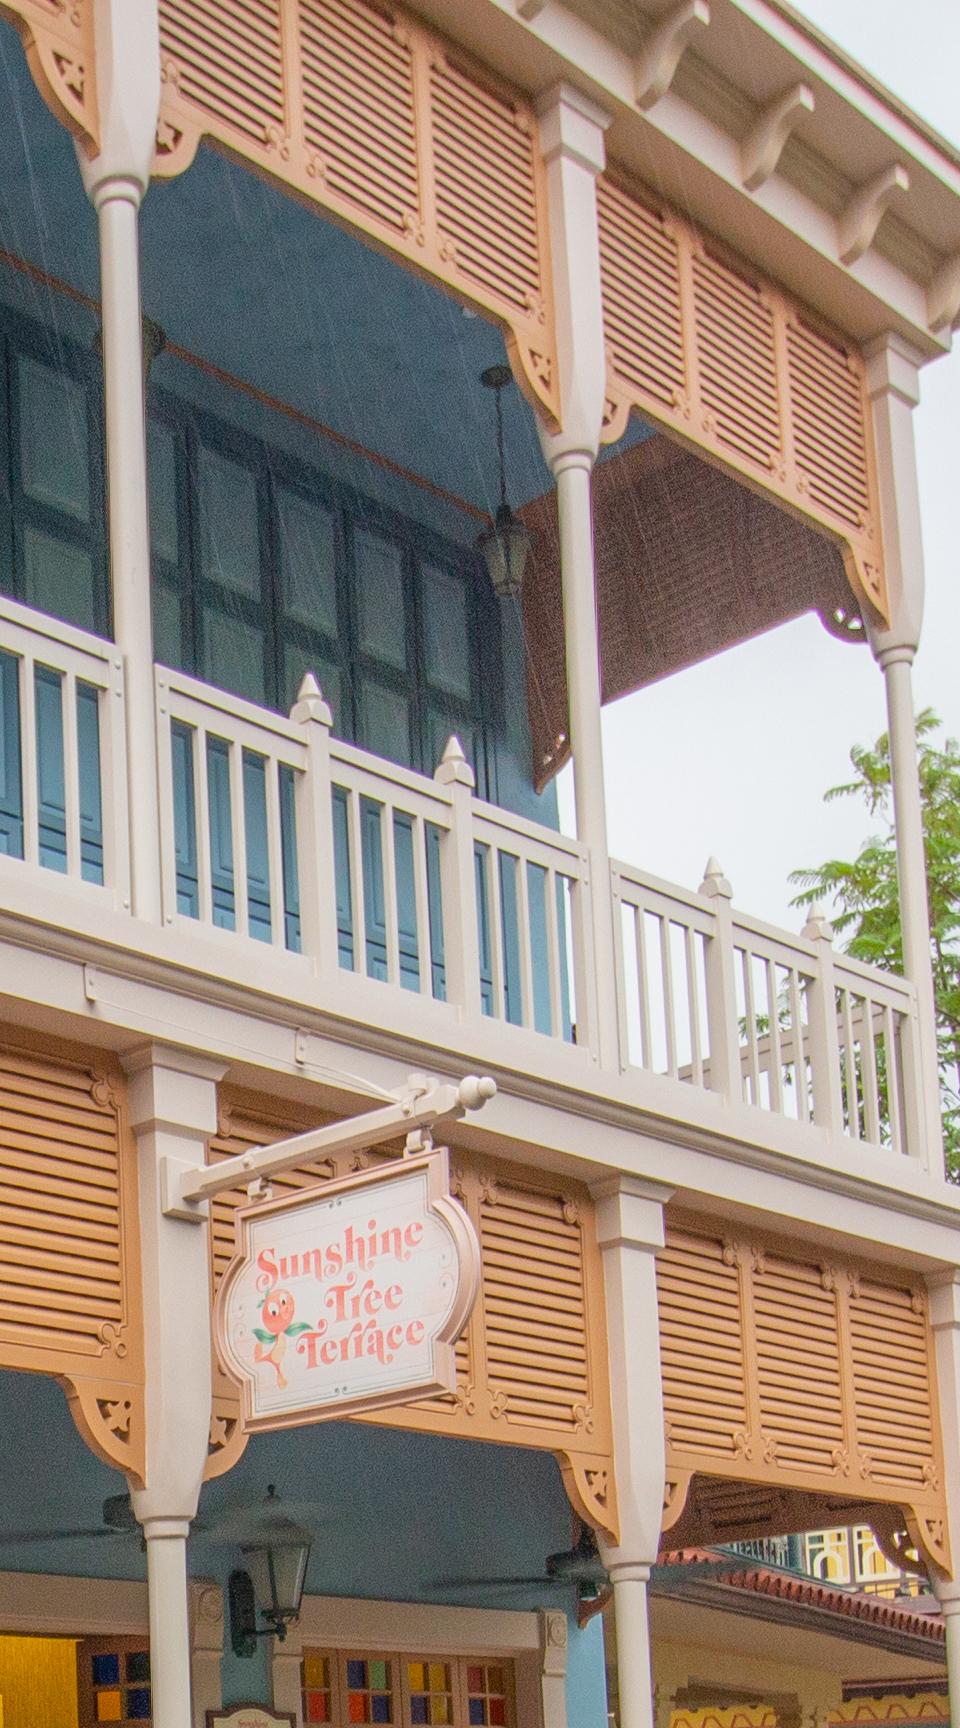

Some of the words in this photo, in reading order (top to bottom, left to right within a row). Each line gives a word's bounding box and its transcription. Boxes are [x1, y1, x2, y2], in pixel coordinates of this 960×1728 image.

[255, 1219, 424, 1292] Sunshine
[324, 1272, 404, 1323] Tree
[296, 1318, 426, 1369] Terrace
